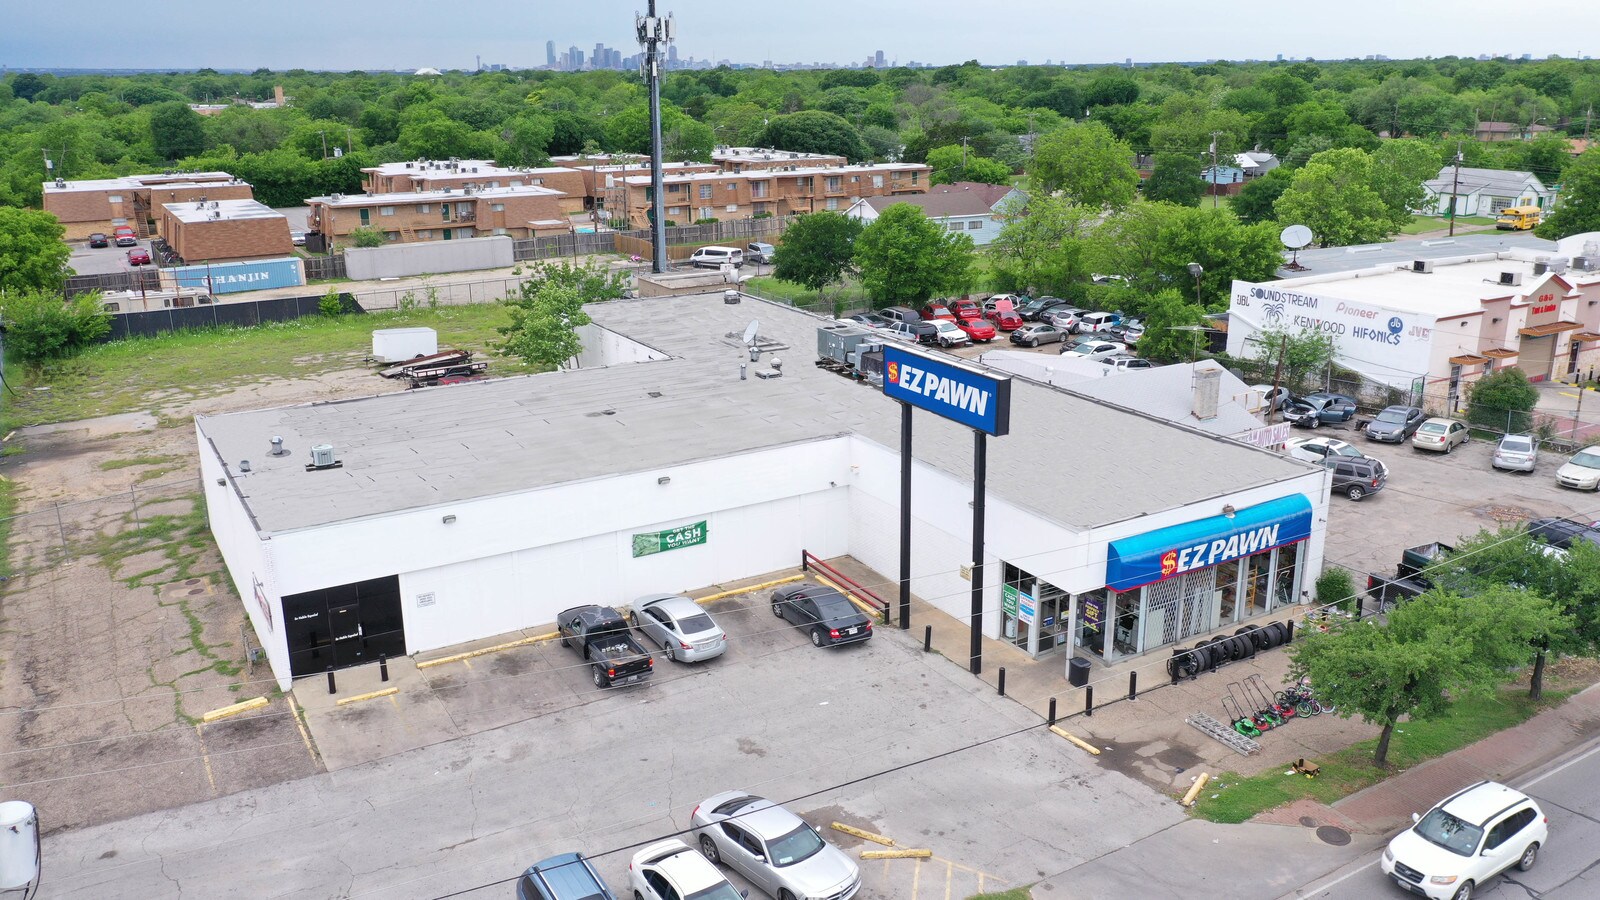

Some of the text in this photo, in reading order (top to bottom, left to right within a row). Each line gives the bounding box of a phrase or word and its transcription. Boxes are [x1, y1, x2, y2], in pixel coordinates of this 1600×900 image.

[215, 271, 270, 284] HANJIN
[1250, 287, 1318, 309] SOUNDSTREAM
[1335, 302, 1379, 320] Pioneer
[1293, 314, 1346, 336] KENWOOD
[1352, 325, 1401, 346] HIFONICS
[666, 528, 700, 543] CASH
